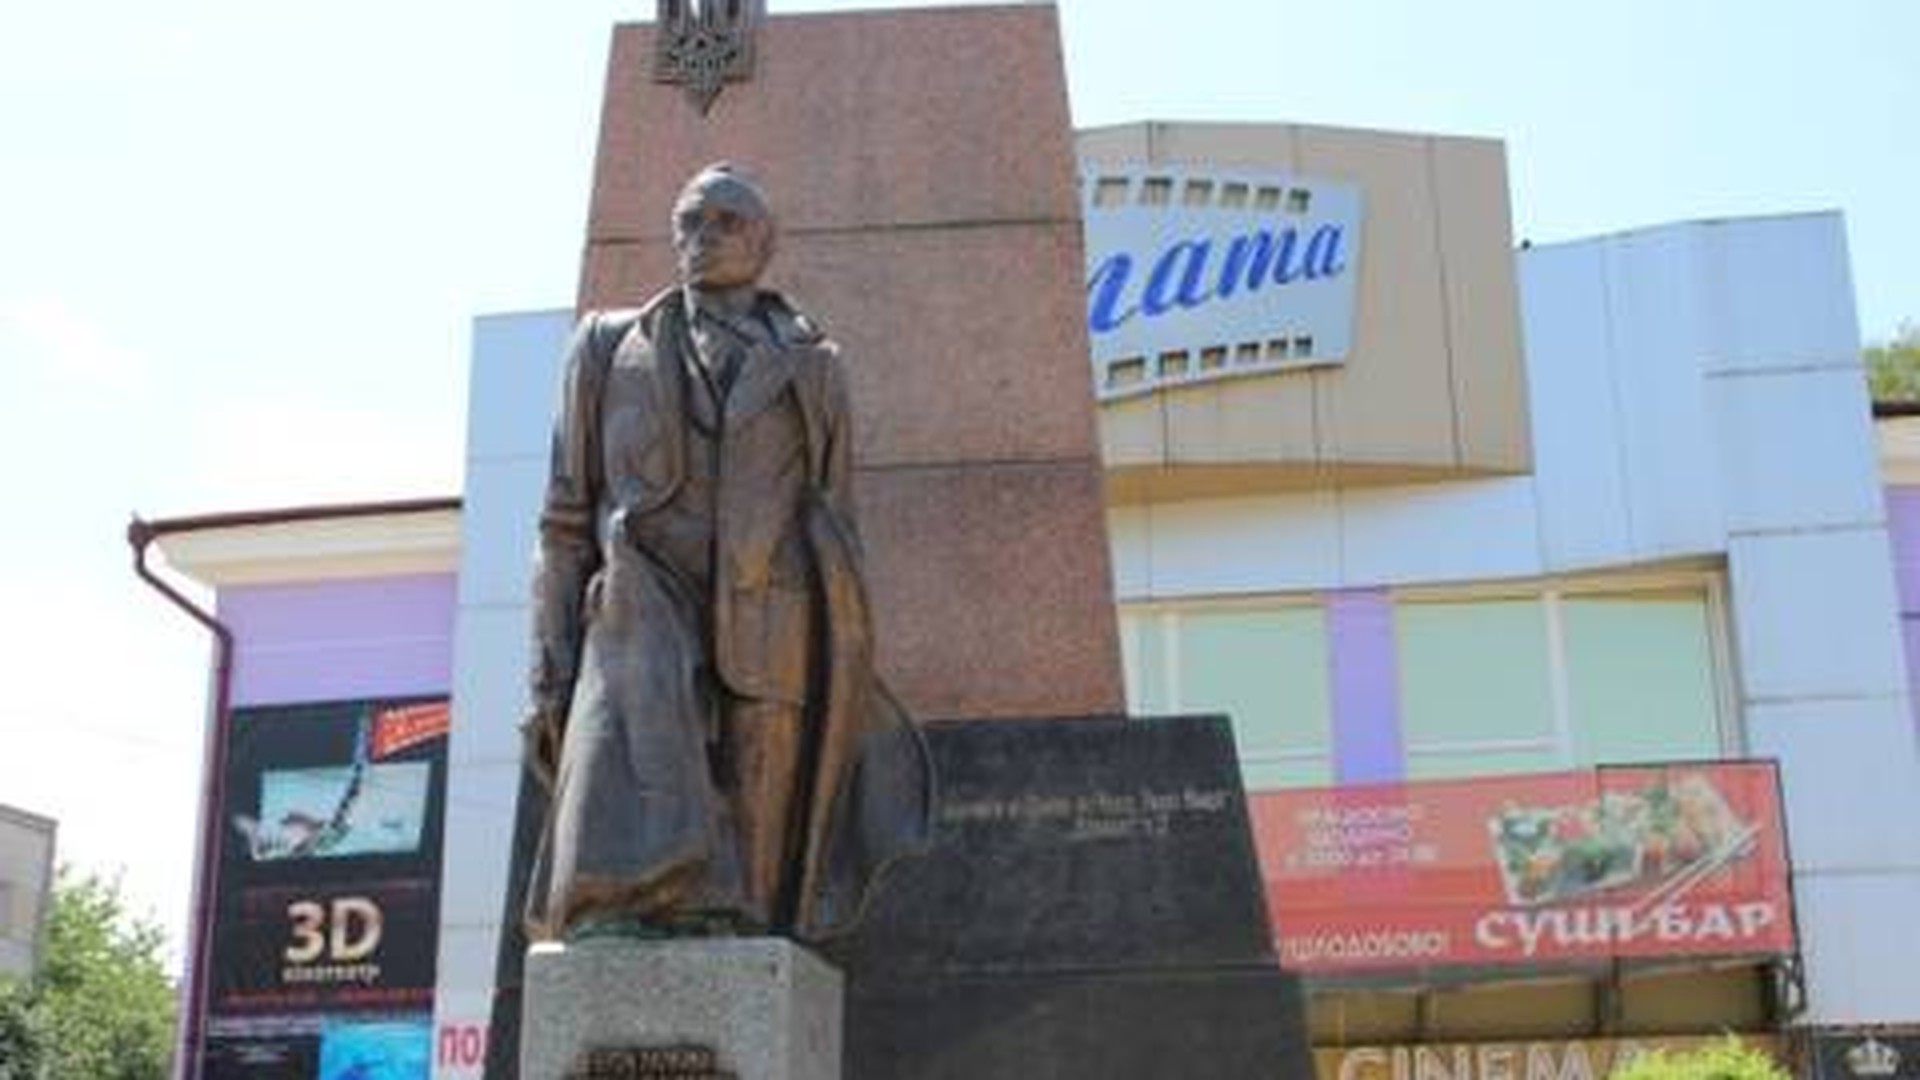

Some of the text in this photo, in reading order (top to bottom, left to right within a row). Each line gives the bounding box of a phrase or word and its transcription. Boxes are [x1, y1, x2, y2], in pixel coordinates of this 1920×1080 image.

[1087, 223, 1345, 334] лата
[285, 896, 384, 963] 3D
[437, 1025, 484, 1067] ПО
[1339, 1040, 1638, 1080] CINEM
